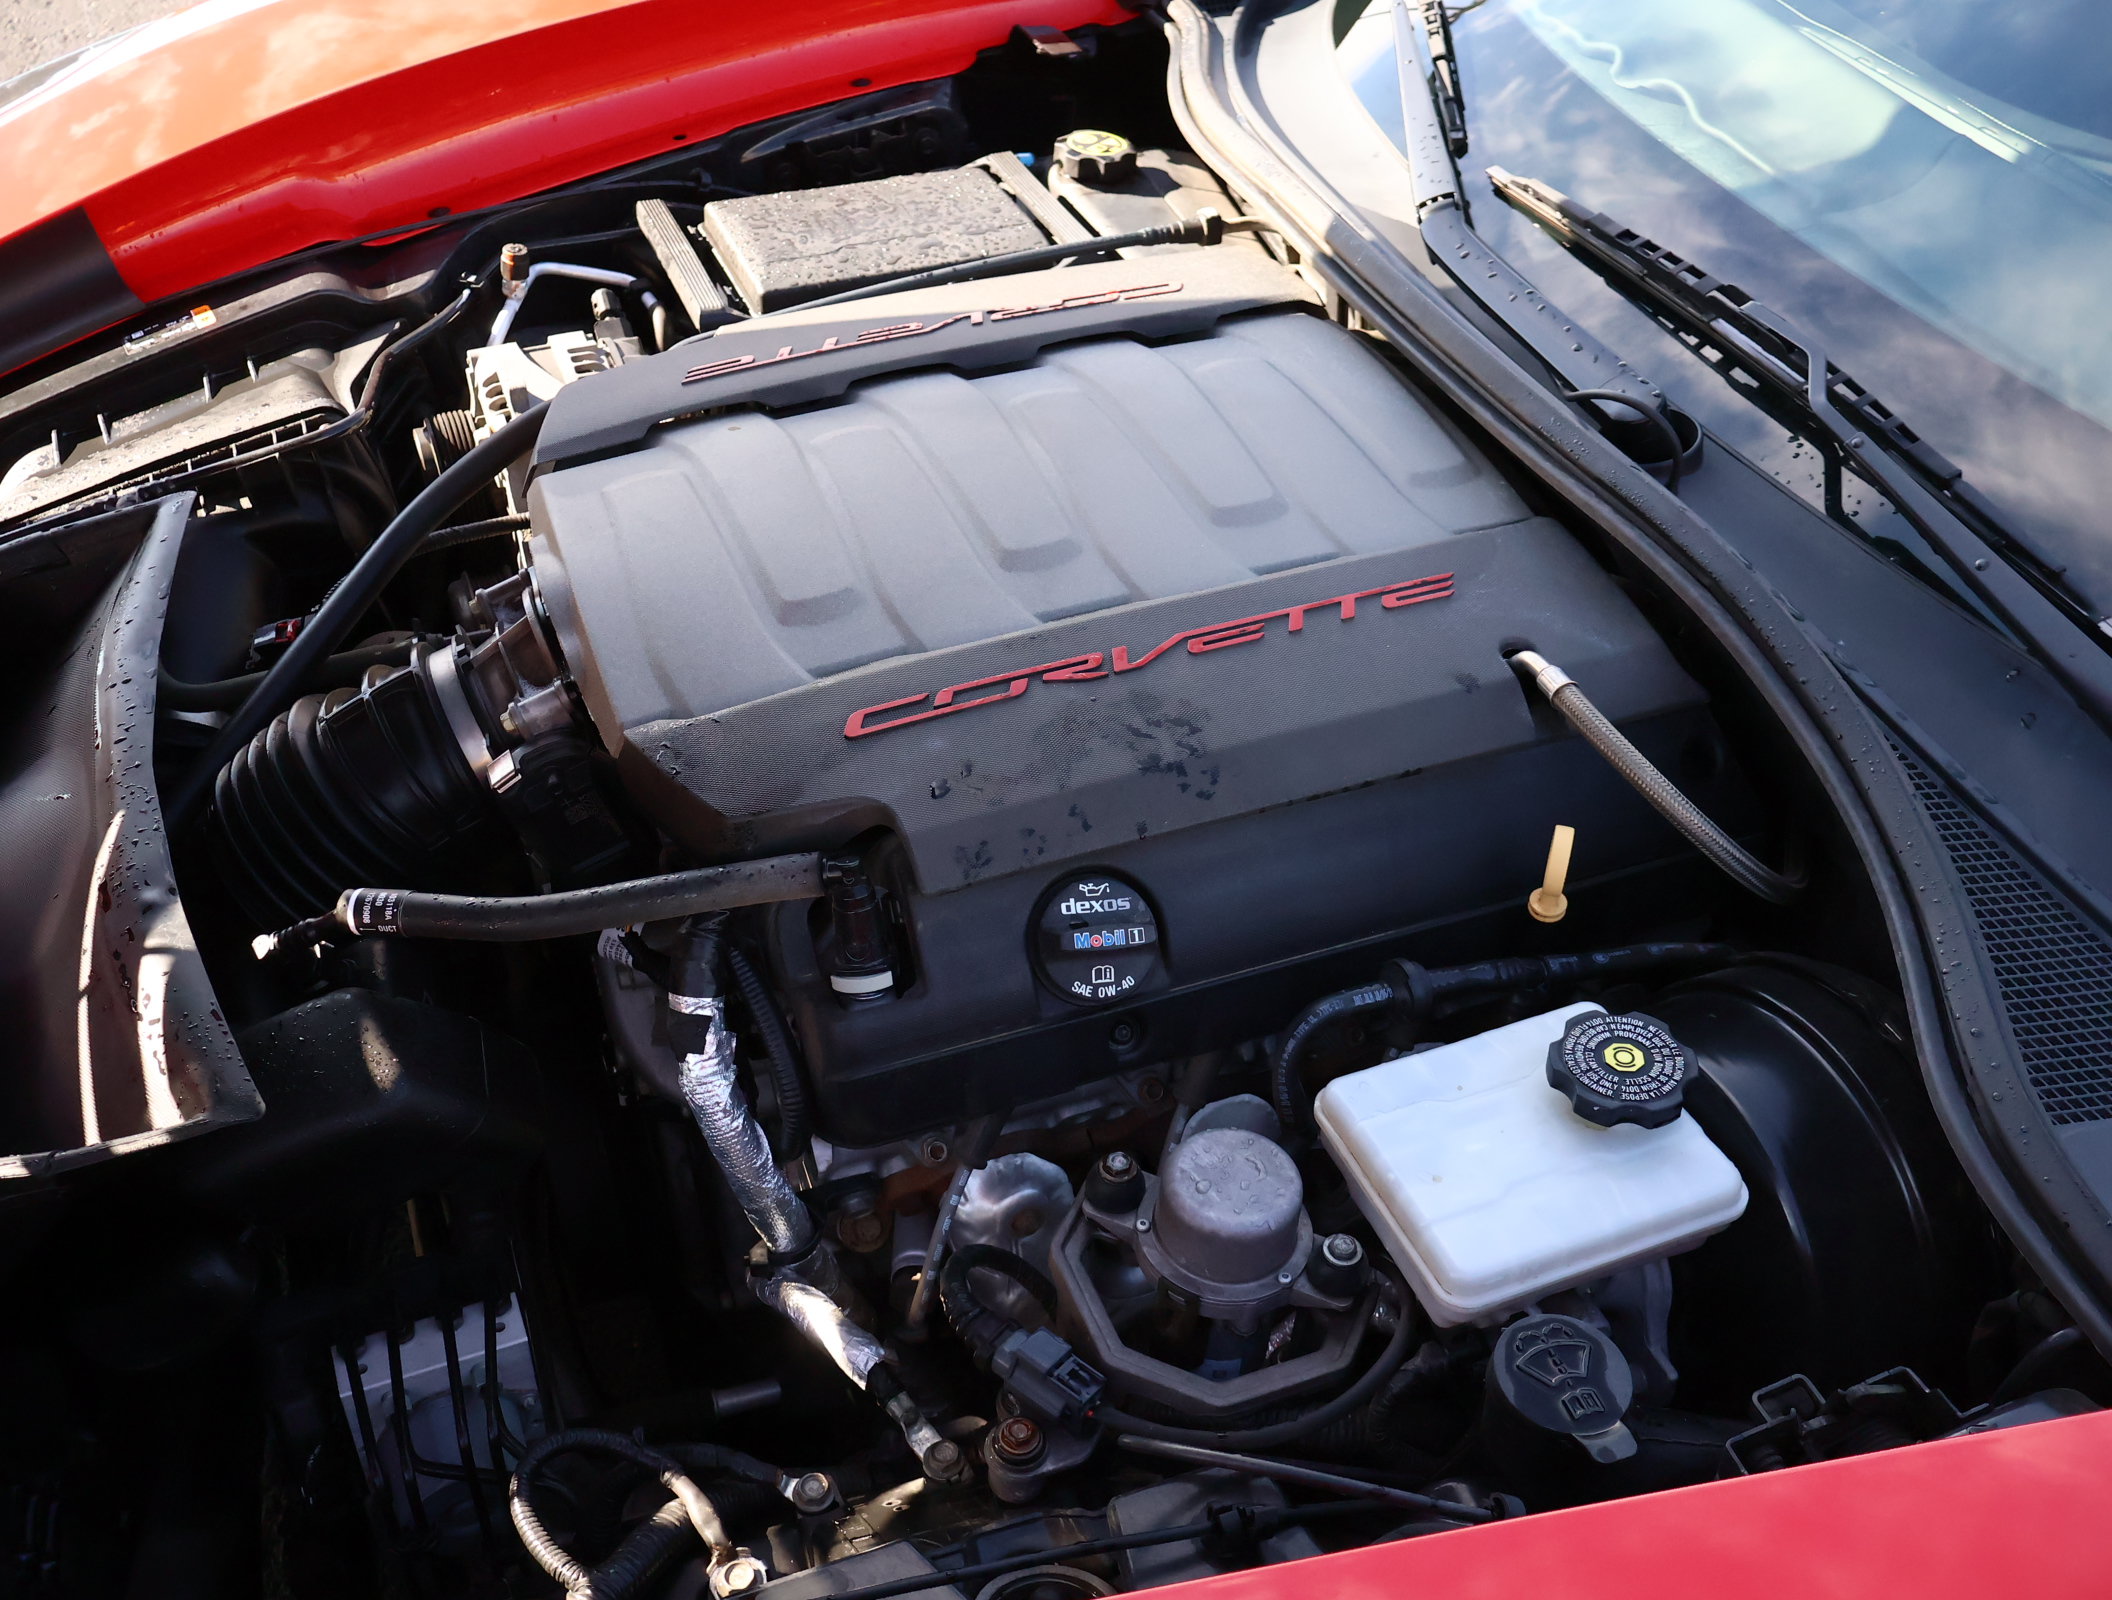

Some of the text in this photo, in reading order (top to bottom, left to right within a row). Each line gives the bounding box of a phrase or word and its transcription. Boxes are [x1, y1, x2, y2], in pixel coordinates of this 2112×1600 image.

[682, 281, 1184, 384] CORVETTE
[843, 571, 1455, 739] CORVETTE
[1060, 897, 1131, 915] dexos
[1073, 928, 1126, 949] Mobil
[1071, 975, 1135, 998] SAE 0W-40
[1571, 1023, 1589, 1037] FLUID
[1595, 1024, 1609, 1033] CAP
[1564, 1034, 1577, 1050] FROM
[1577, 1028, 1597, 1046] BEFORE
[1613, 1030, 1656, 1049] PROVENANT
[1647, 1025, 1678, 1049] NETTOYER
[1651, 1036, 1666, 1048] QUE
[1660, 1047, 1672, 1056] DU
[1672, 1048, 1683, 1056] LE
[1565, 1054, 1581, 1075] SEALED
[1585, 1051, 1599, 1070] CLEAN
[1594, 1067, 1620, 1083] FILLER
[1586, 1070, 1601, 1082] USE
[1657, 1075, 1669, 1084] DE
[1599, 1079, 1618, 1090] ONLY
[1640, 1080, 1661, 1092] FREIN
[1659, 1079, 1678, 1095] AVANT
[1649, 1089, 1661, 1099] LA
